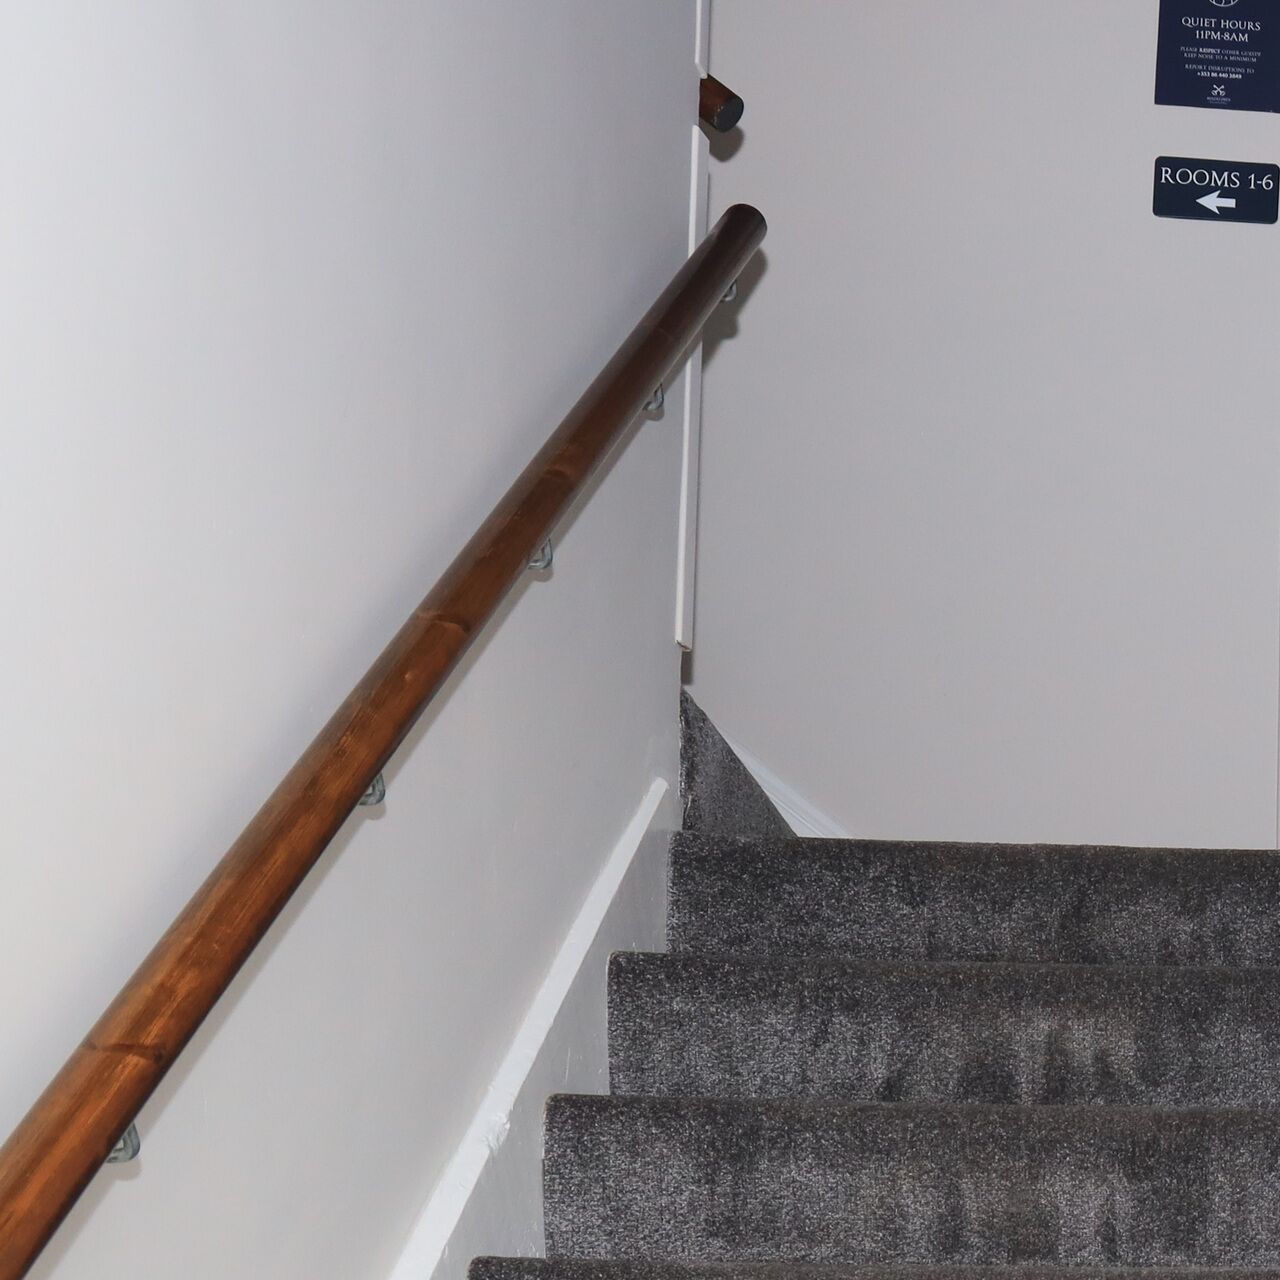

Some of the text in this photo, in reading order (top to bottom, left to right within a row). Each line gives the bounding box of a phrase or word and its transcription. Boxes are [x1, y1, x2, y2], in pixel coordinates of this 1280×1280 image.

[1181, 16, 1261, 31] QUIET HOURS
[1195, 30, 1249, 42] 11PM-8AM
[1160, 166, 1274, 190] ROOMS 1-6
